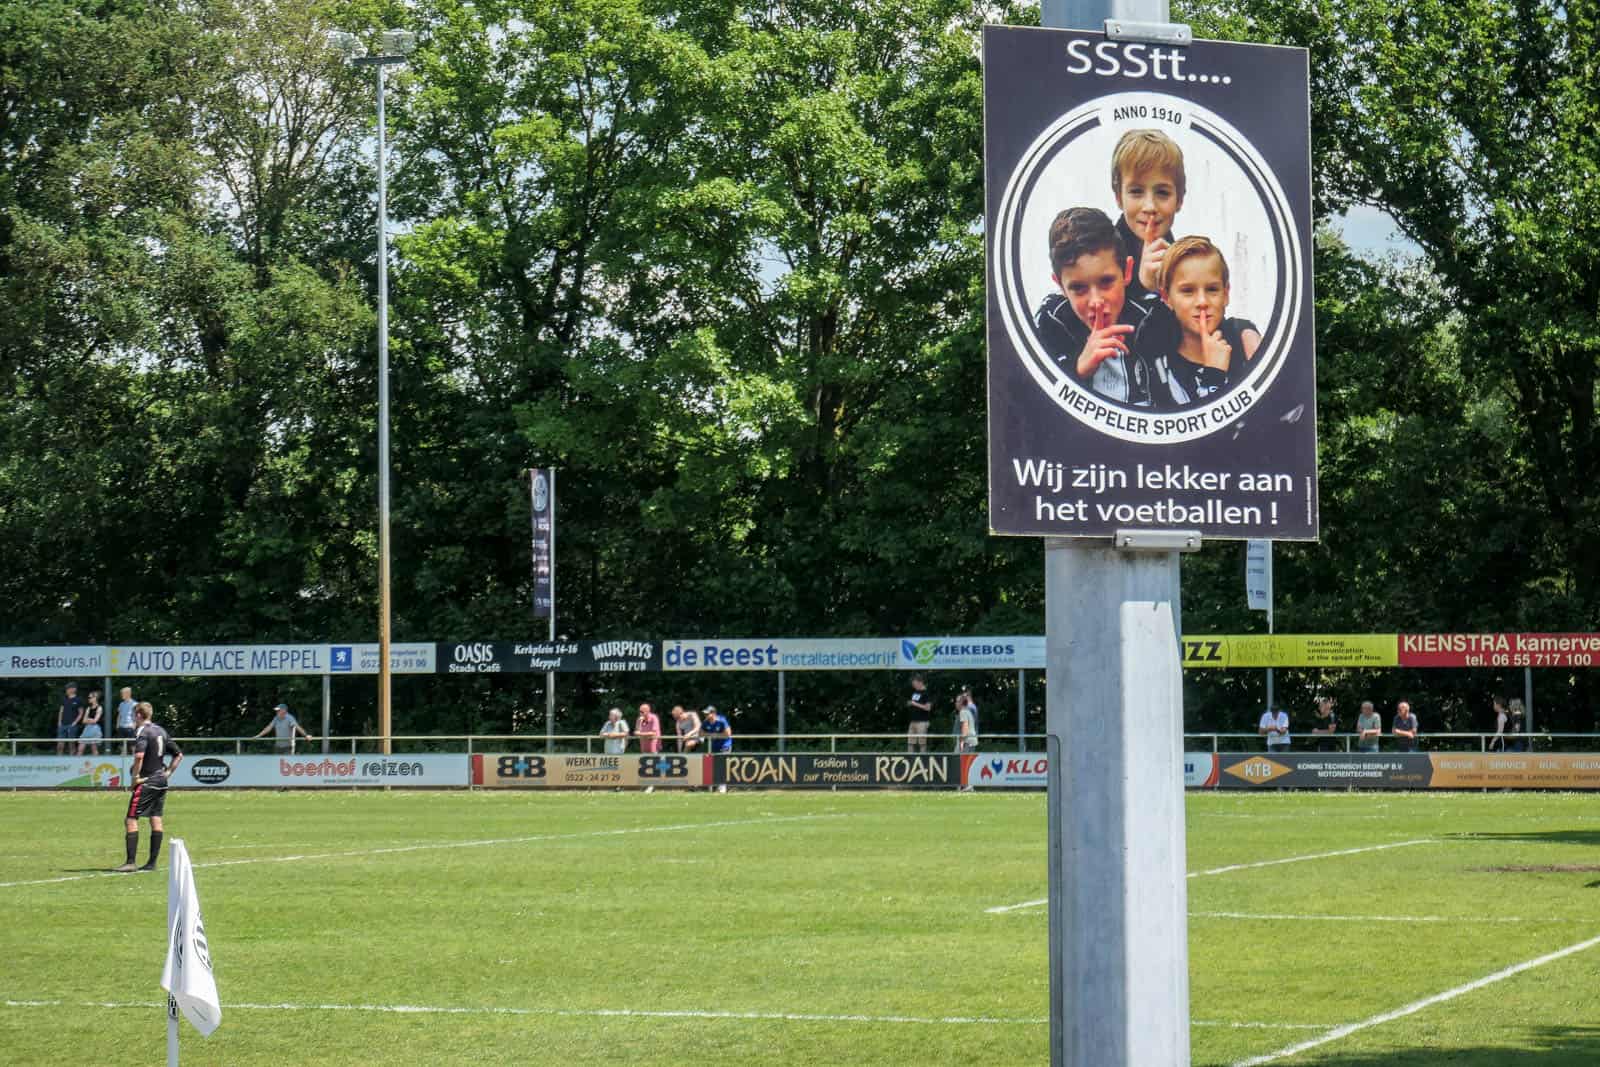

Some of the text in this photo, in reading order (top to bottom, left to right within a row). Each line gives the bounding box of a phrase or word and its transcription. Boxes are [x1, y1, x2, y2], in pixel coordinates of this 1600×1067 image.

[1066, 39, 1232, 84] SSStt....
[1113, 106, 1182, 125] ANNO 1910
[1058, 384, 1252, 435] MEPPELER SPORT CLUB
[1013, 458, 1293, 494] Wij zijn lekker aan
[1035, 496, 1088, 521] het
[1096, 499, 1262, 524] voetballen
[454, 642, 494, 663] OASIS
[934, 644, 1015, 656] KIEKEBOS
[1182, 641, 1222, 661] ZZ
[1403, 635, 1510, 652] KIENSTRA
[11, 655, 102, 669] Reesttours.nl
[127, 650, 321, 671] AUTO PALACE MEPPEL
[530, 657, 561, 670] Meppel
[666, 643, 778, 667] de Reest
[782, 651, 897, 668] installatiebedrijf
[1465, 653, 1591, 666] tel. 06 55 717 100
[600, 662, 646, 672] IRISH PUB
[280, 758, 423, 777] boerhof reizen
[566, 757, 620, 768] WERKT MEE
[725, 756, 796, 782] ROAN
[813, 758, 859, 768] Fashion is
[875, 756, 947, 782] ROAN
[1006, 759, 1048, 774] KLO
[1245, 763, 1272, 777] KTB
[803, 772, 868, 782] our Profession
